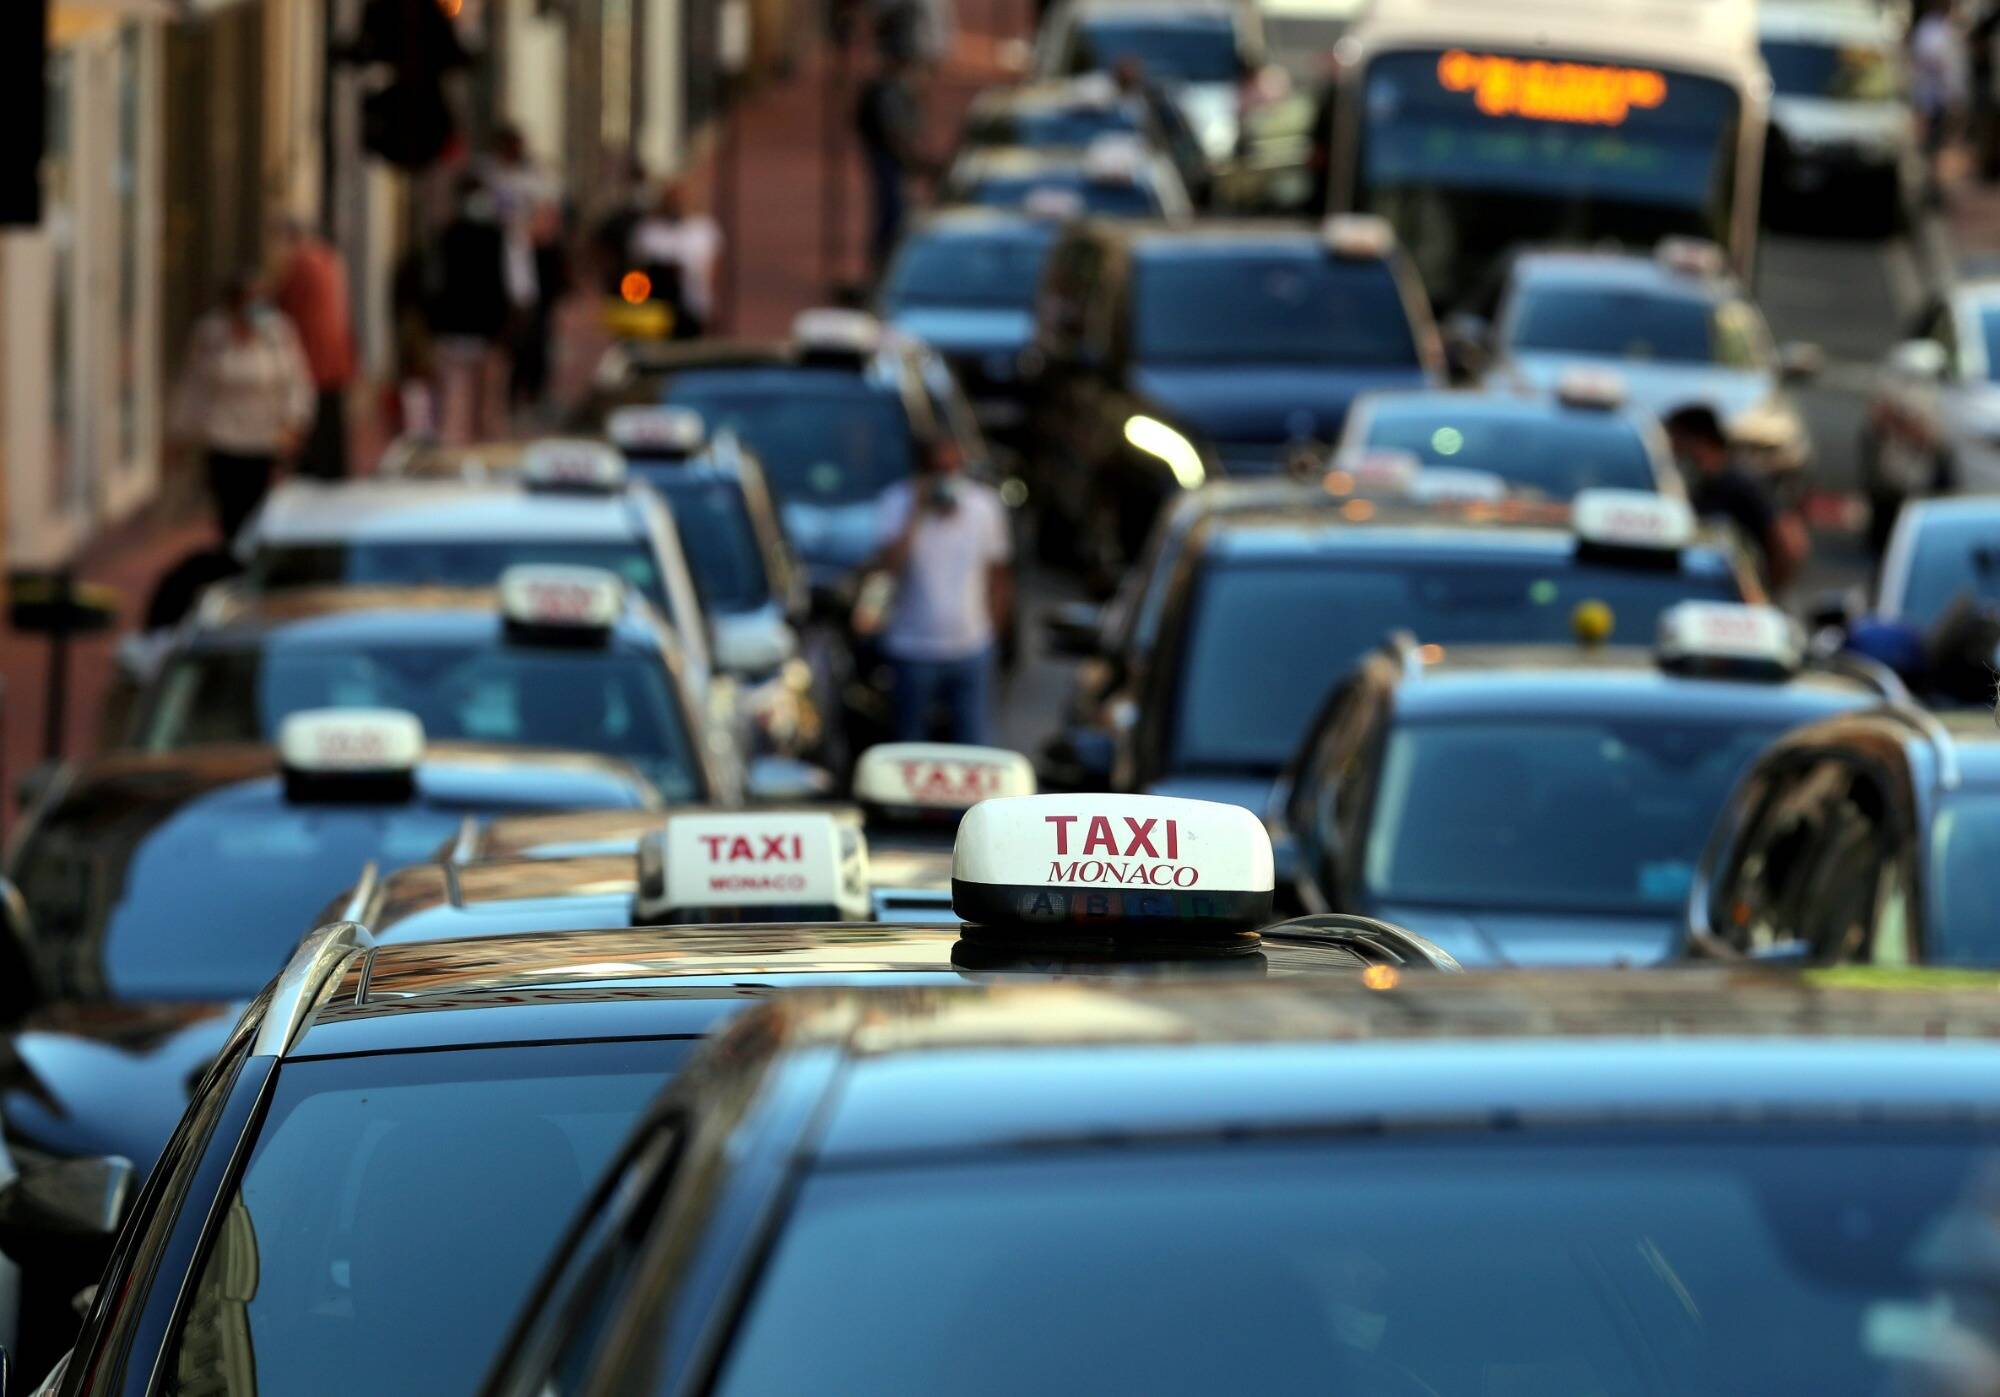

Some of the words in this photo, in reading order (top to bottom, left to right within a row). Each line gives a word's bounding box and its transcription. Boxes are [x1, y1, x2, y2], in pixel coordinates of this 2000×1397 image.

[902, 759, 1001, 792] TAXI
[698, 833, 804, 861] TAXI
[1045, 815, 1178, 860] TAXI
[1046, 860, 1200, 887] MONACO
